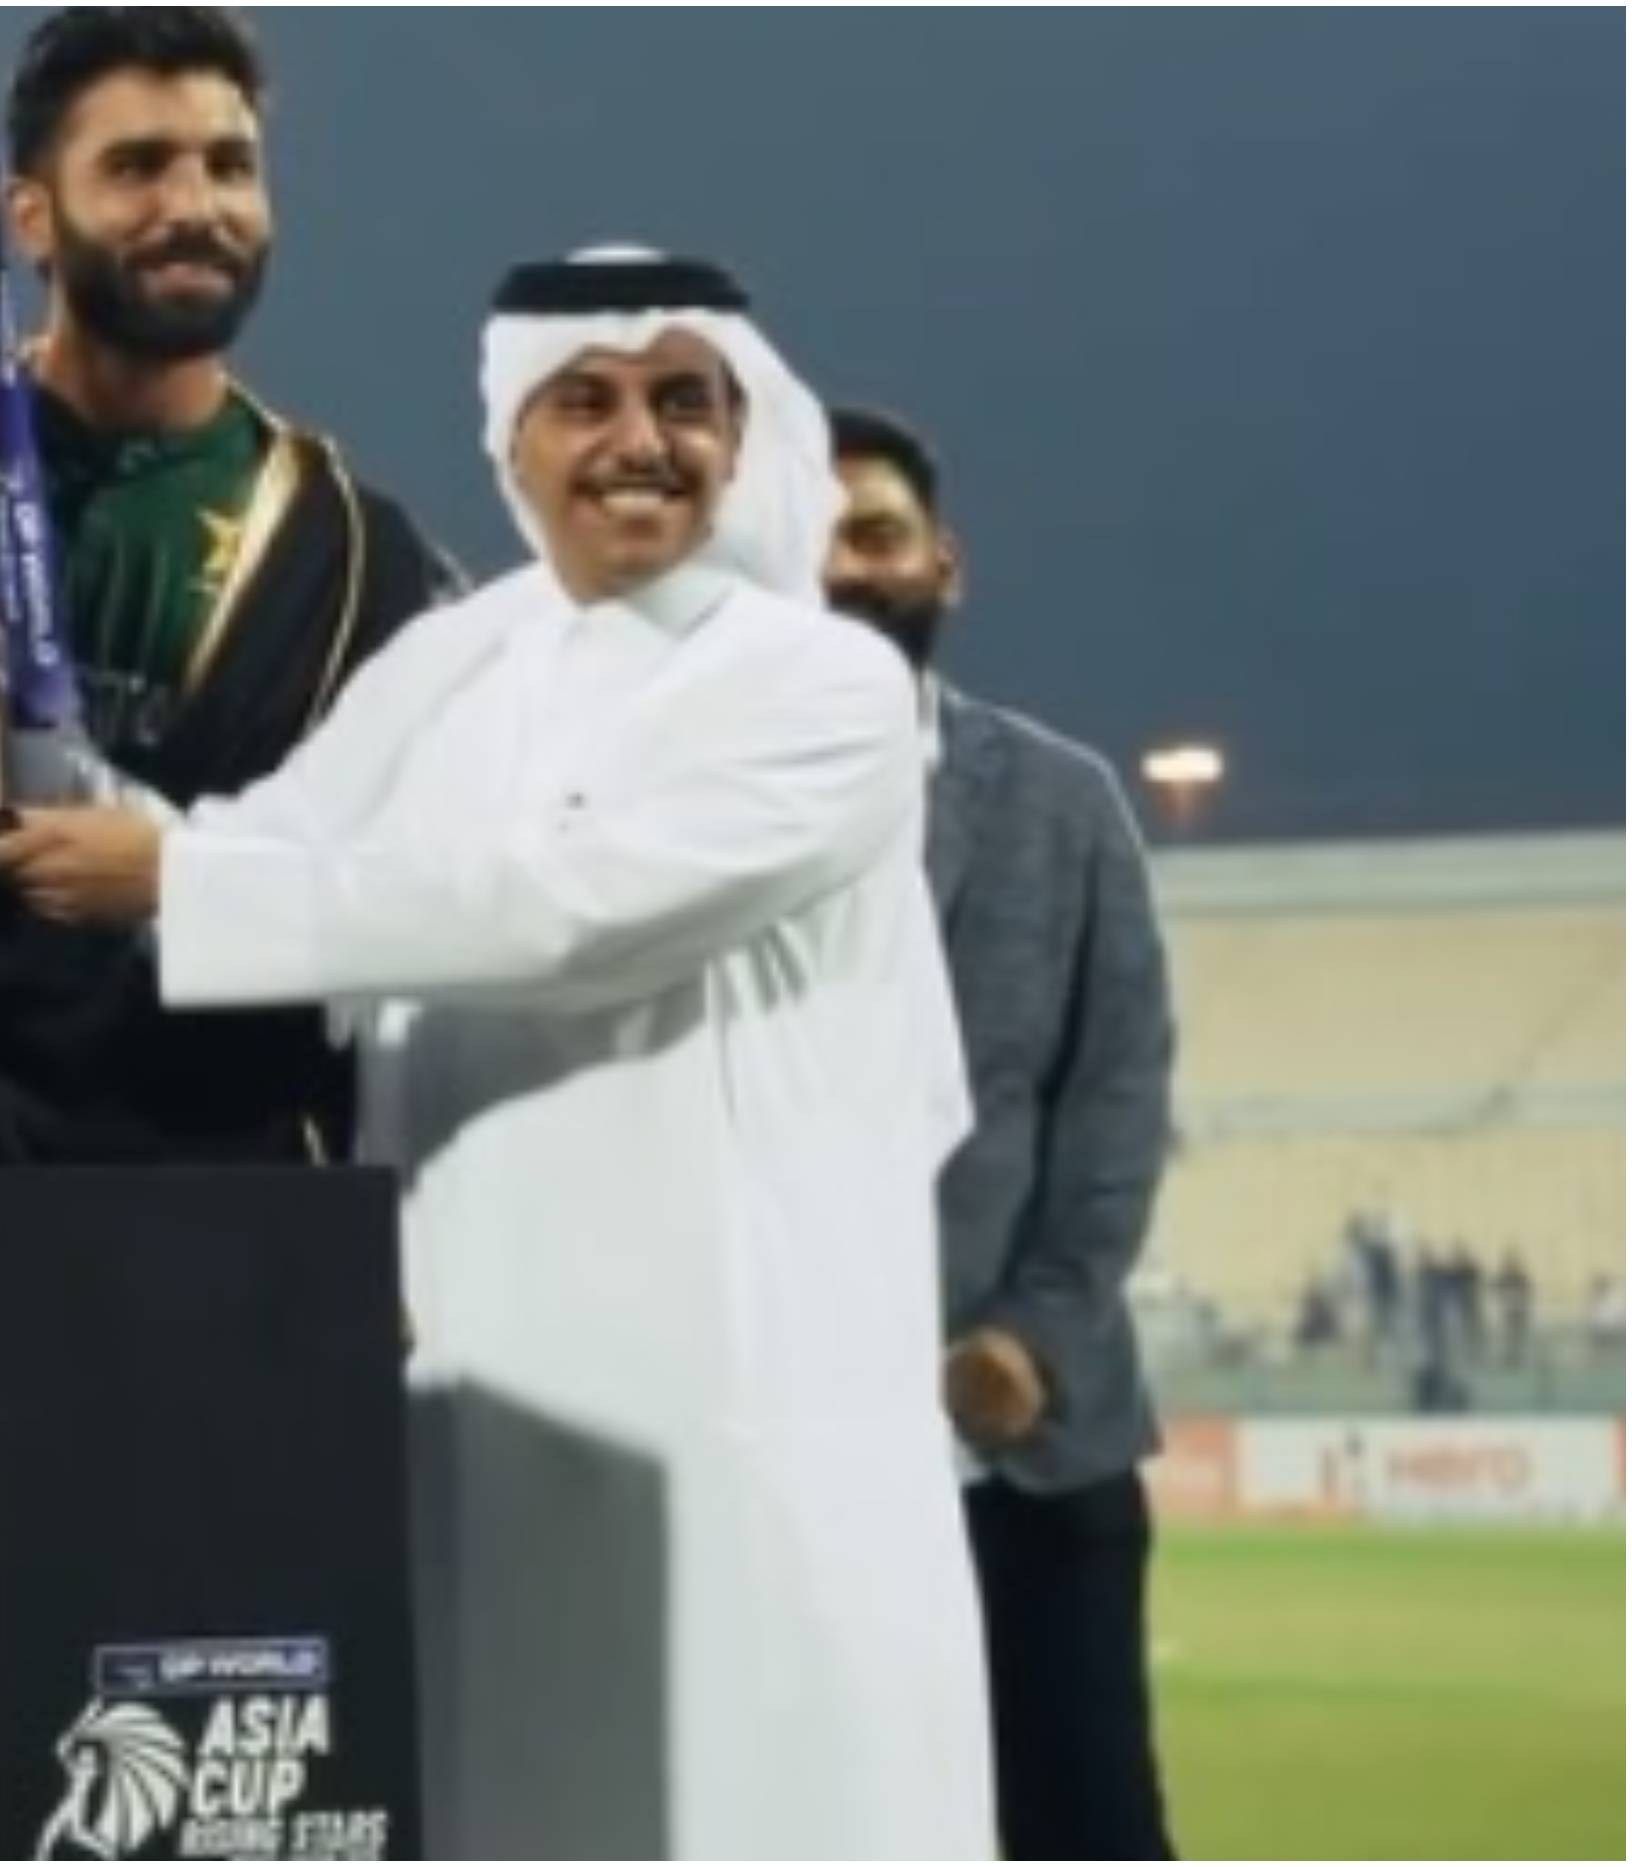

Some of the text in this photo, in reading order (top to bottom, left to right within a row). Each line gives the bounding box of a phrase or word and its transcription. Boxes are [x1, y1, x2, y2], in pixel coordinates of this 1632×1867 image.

[198, 1695, 331, 1757] ASIA
[190, 1759, 306, 1816] CUP
[179, 1810, 388, 1857] RISING STARS
